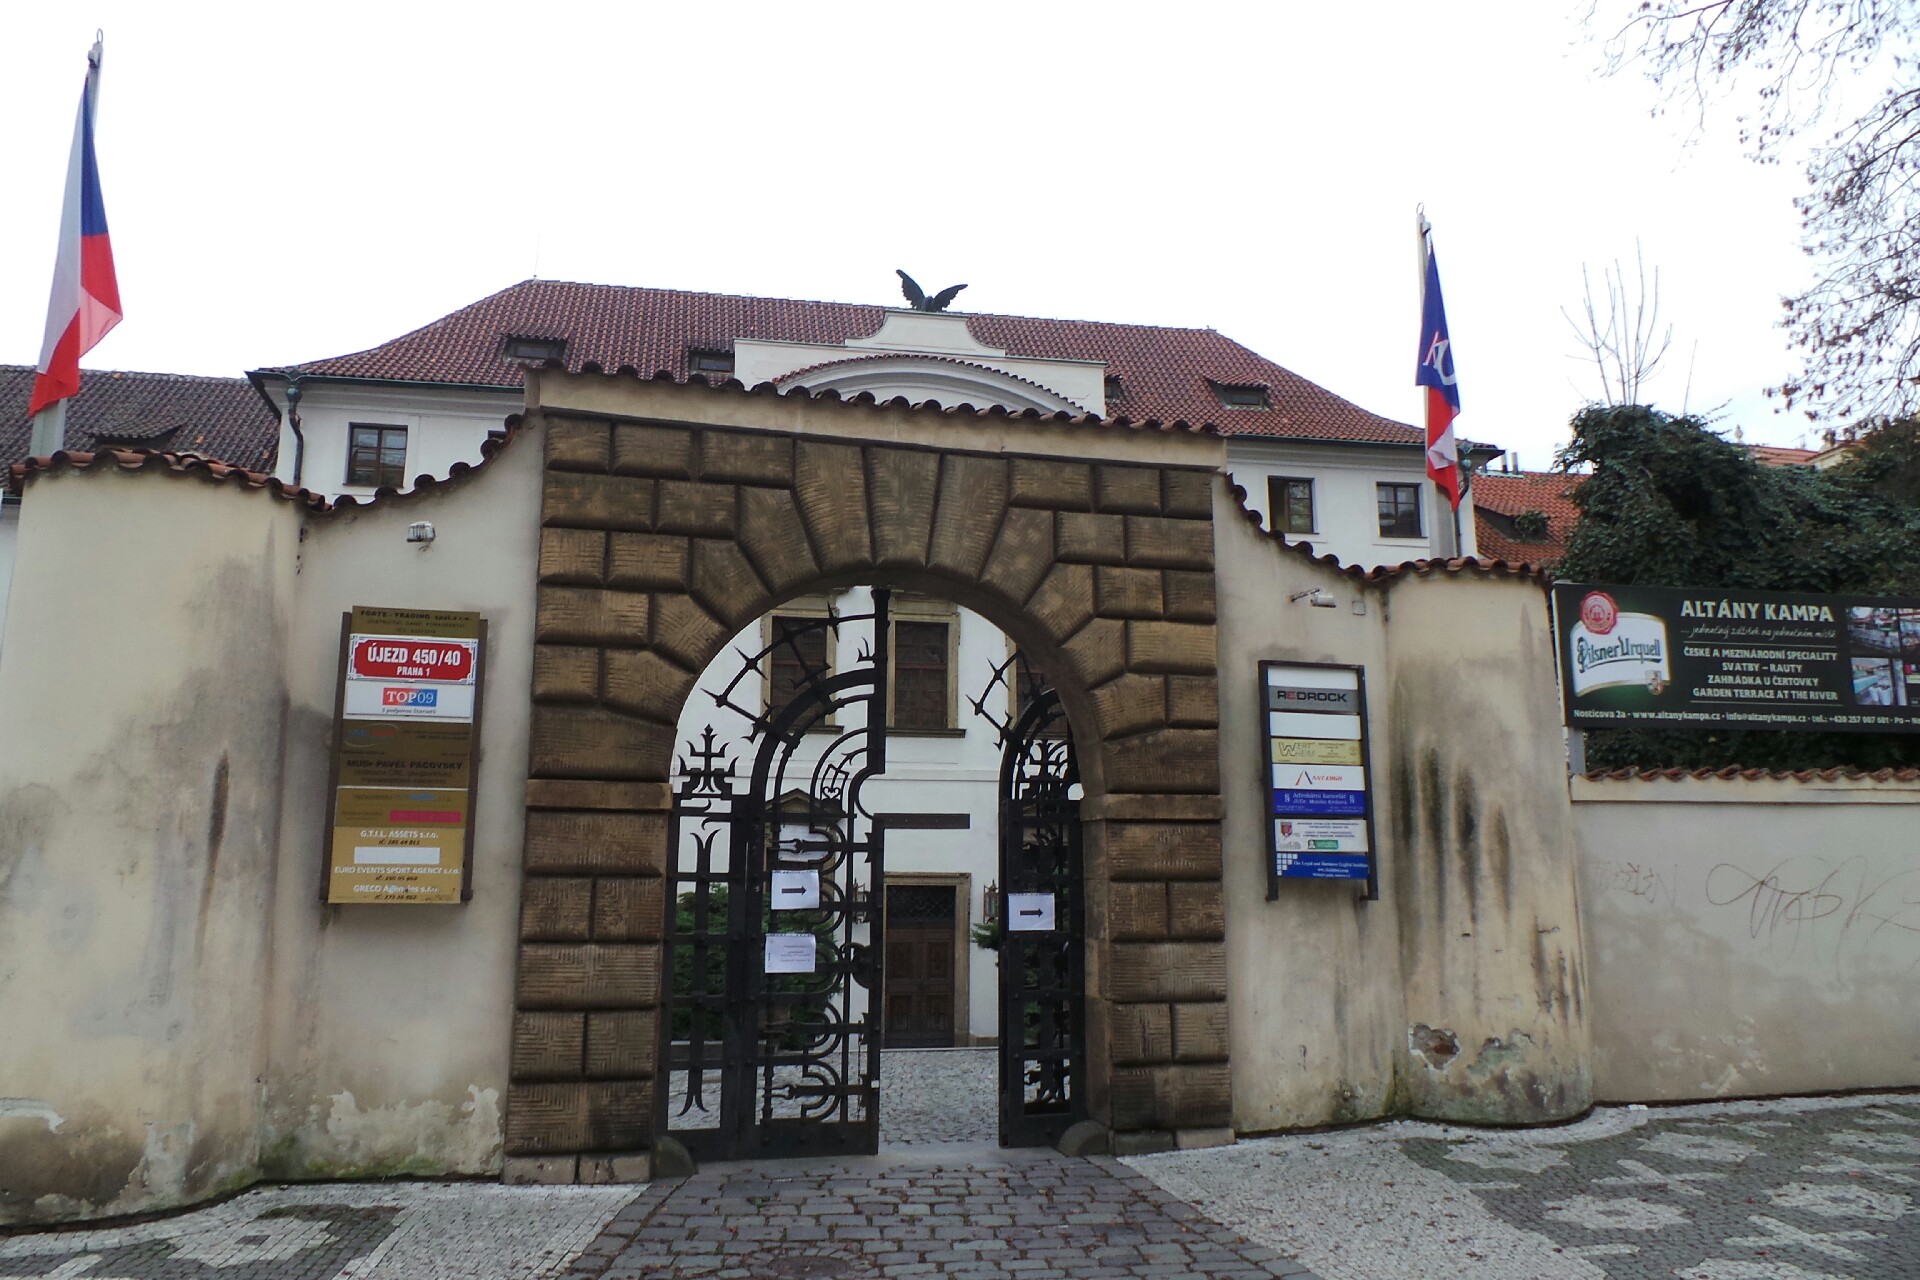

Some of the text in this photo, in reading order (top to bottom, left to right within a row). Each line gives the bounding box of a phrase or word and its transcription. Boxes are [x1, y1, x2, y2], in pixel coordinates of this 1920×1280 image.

[395, 612, 430, 620] TRADING
[1680, 598, 1835, 623] ALTÁNY KAMPA
[367, 642, 461, 667] ÚJEZD 450/40
[1577, 635, 1661, 673] Pilsner Urquell
[1683, 646, 1710, 657] ČESKÉ
[1721, 648, 1785, 659] MEZINÁRODNÍ
[1786, 650, 1838, 660] SPECIALITY
[396, 666, 431, 676] PRAHA 1
[1722, 662, 1760, 672] SVATBY
[1769, 663, 1803, 673] RAUTY
[1707, 674, 1819, 686] ZAHRÁDKA U ČERTOVKY
[1277, 690, 1348, 702] REDROCK
[1693, 687, 1838, 700] GARDEN TERRACE AT THE RIVER
[1616, 710, 1626, 719] 2a
[1632, 710, 1721, 721] www.altanykampa.cz
[1725, 712, 1807, 723] info@altanykampa.cz
[375, 760, 406, 768] PAVEL
[388, 830, 418, 838] ASSETS
[334, 866, 355, 874] EURO
[356, 866, 385, 874] EVENTS
[353, 884, 382, 893] GRECO
